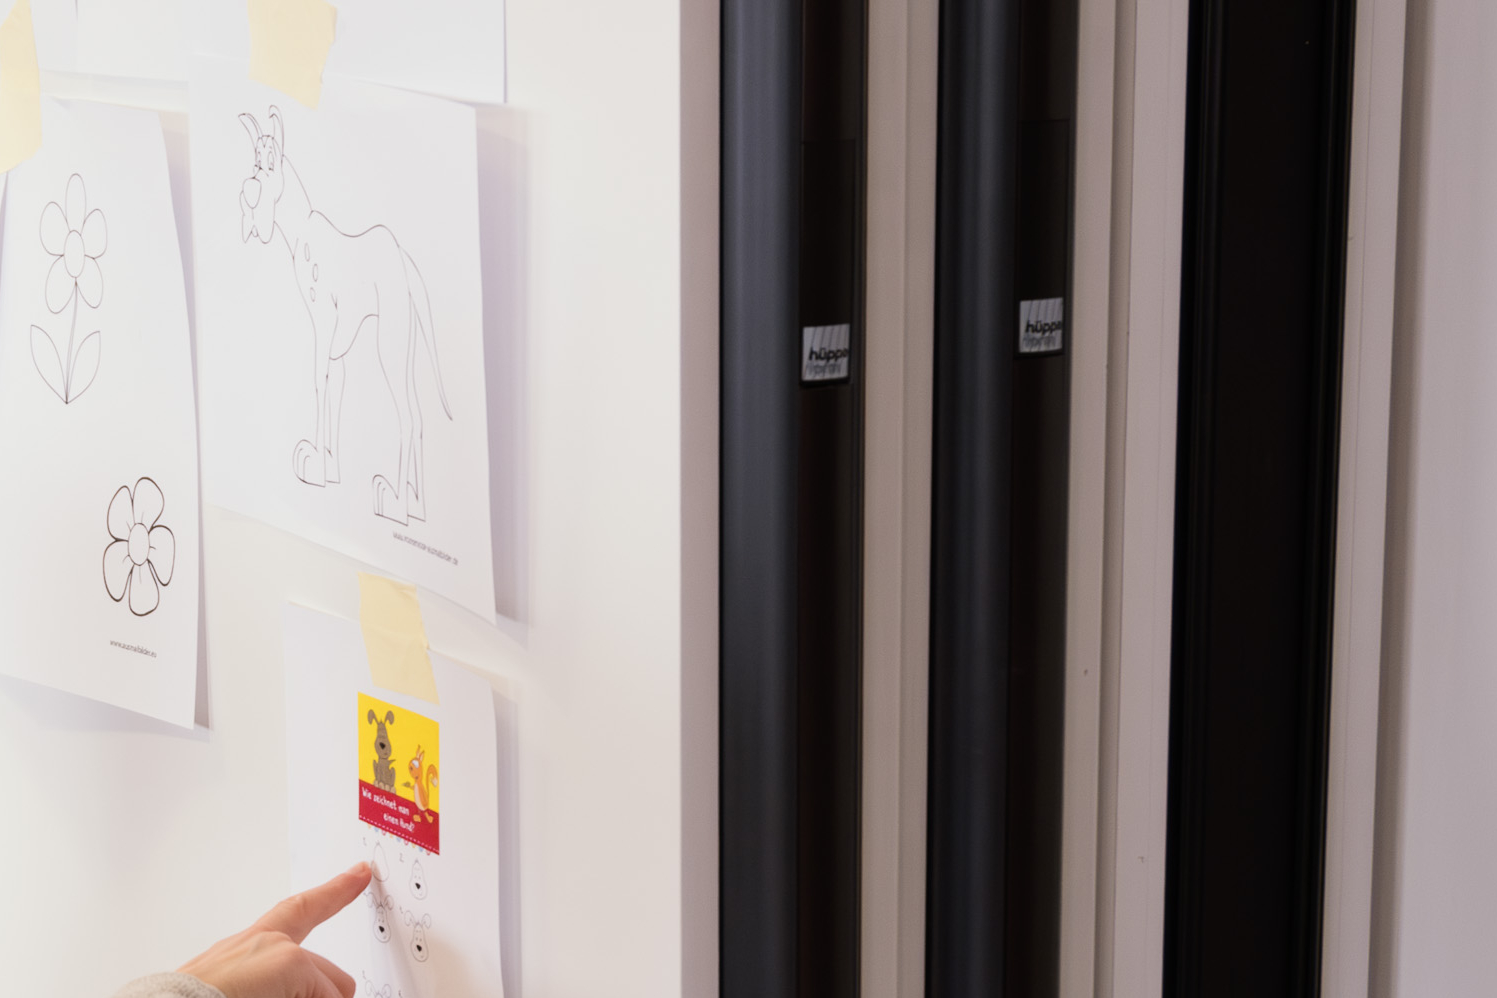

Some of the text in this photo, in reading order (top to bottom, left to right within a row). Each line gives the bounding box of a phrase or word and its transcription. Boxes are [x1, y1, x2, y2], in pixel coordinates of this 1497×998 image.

[362, 786, 372, 800] Wie
[373, 794, 397, 810] zeichnet
[383, 813, 399, 825] einen
